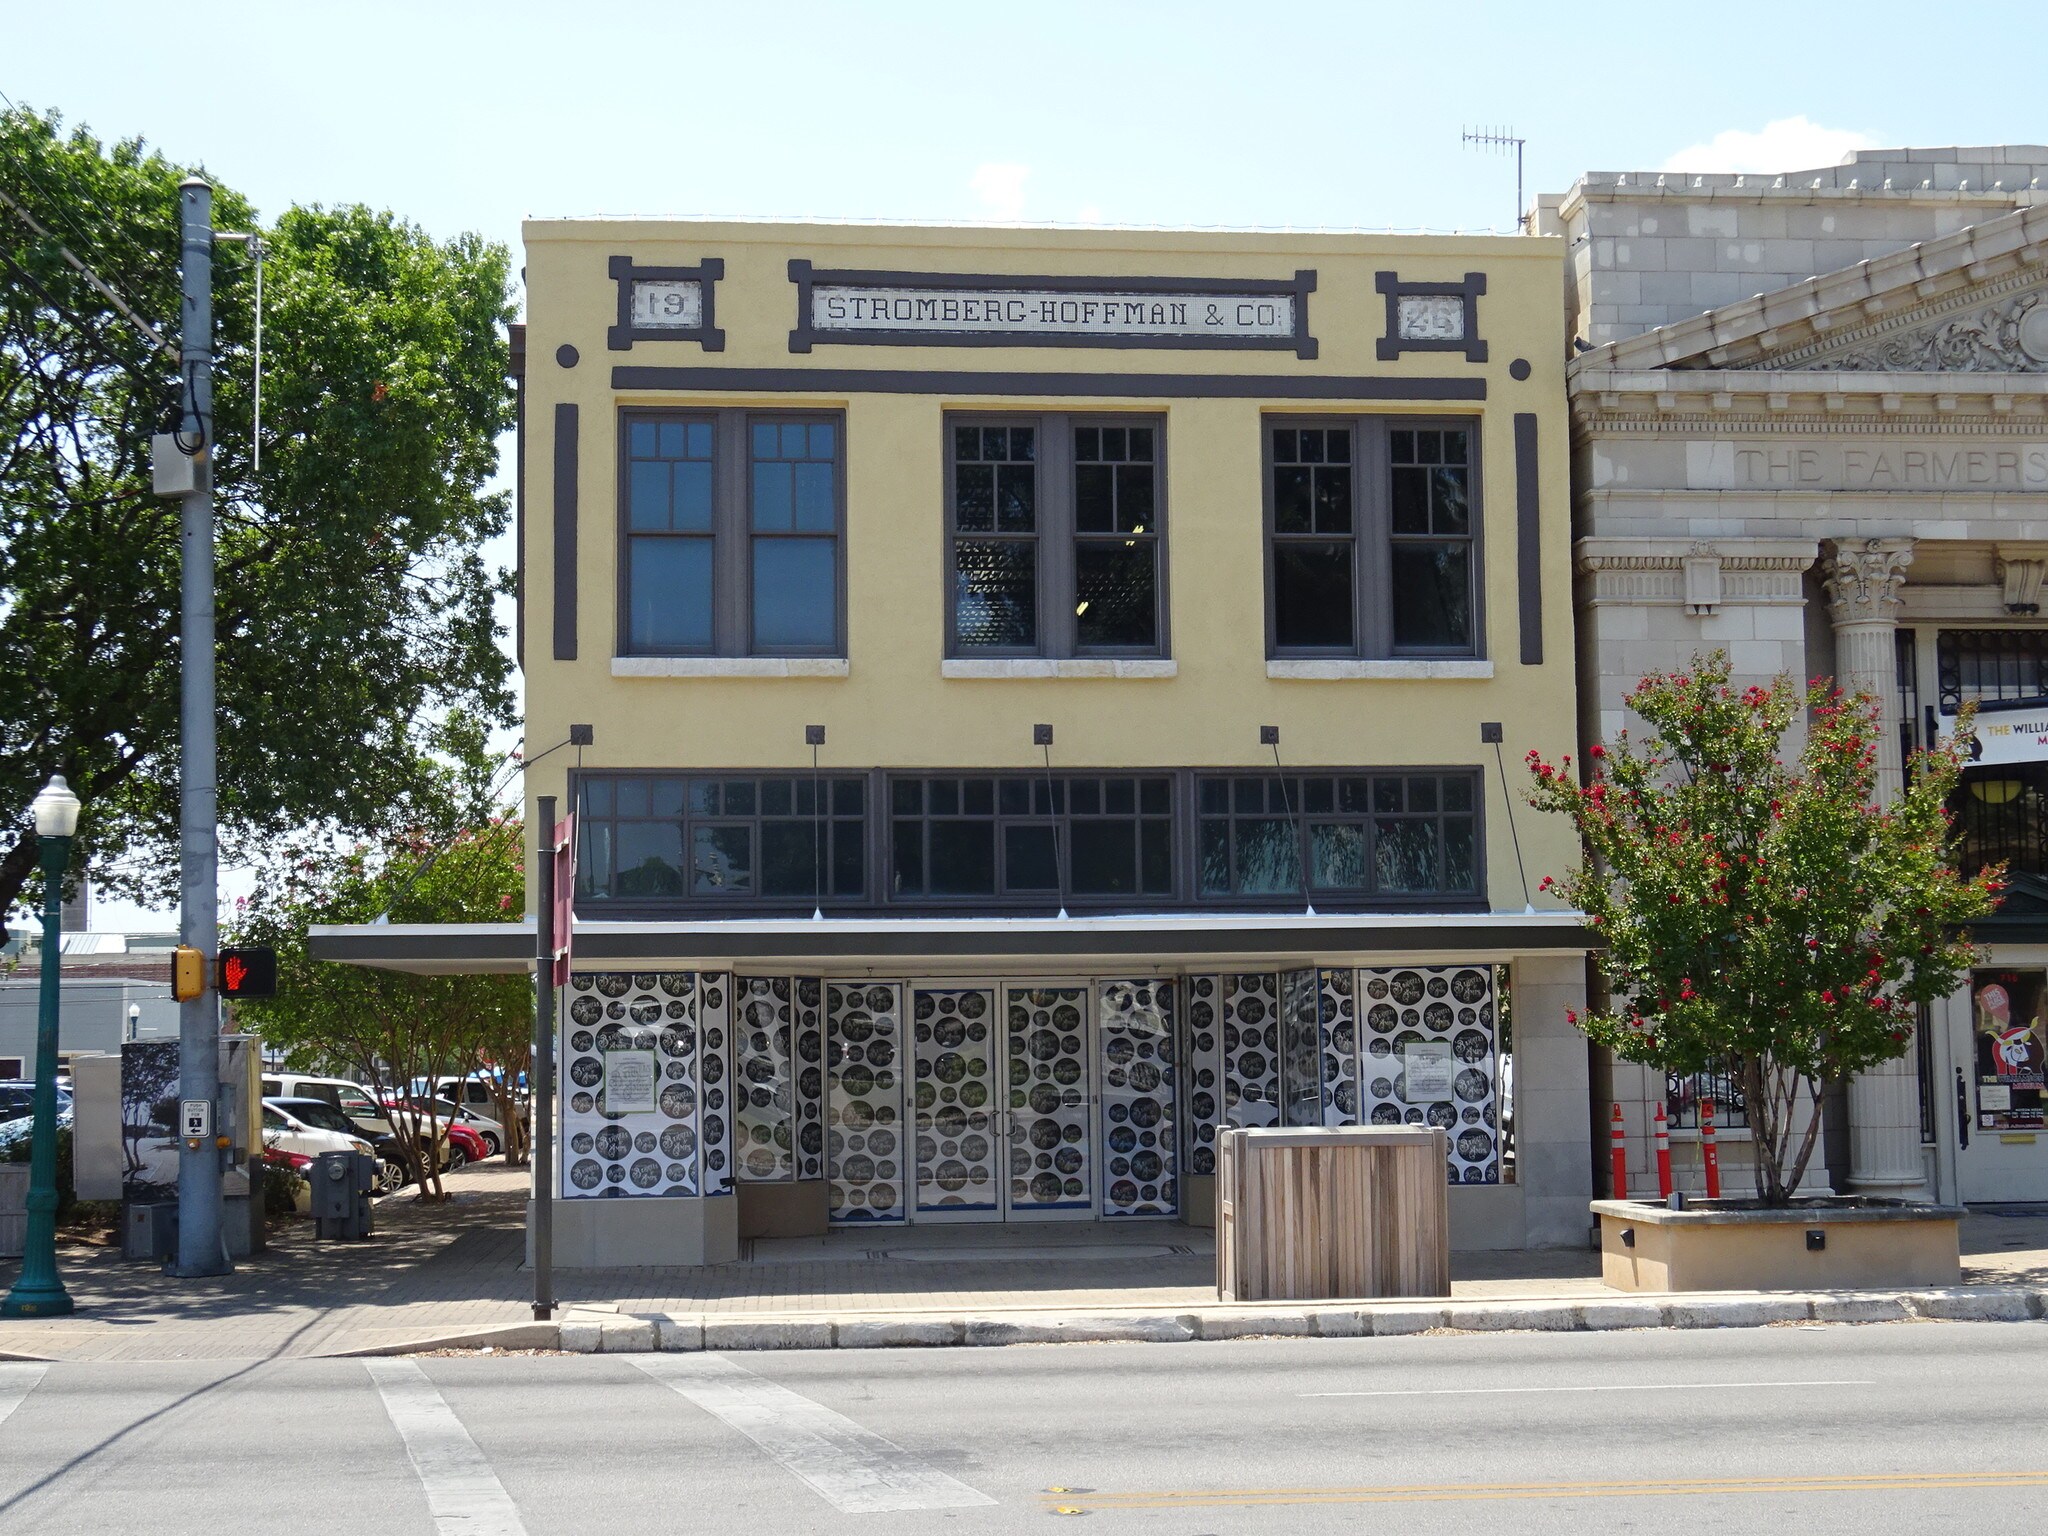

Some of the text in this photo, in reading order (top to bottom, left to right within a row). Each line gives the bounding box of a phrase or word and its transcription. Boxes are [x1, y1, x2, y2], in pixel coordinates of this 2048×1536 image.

[649, 292, 685, 315] 19
[827, 297, 1187, 326] STROMBERG-HOFFMAN
[1204, 304, 1224, 326] &
[1736, 450, 2048, 484] THE FARMERS
[1987, 725, 2010, 736] THE
[1984, 988, 2000, 1002] THIS
[1982, 1075, 1997, 1083] THE
